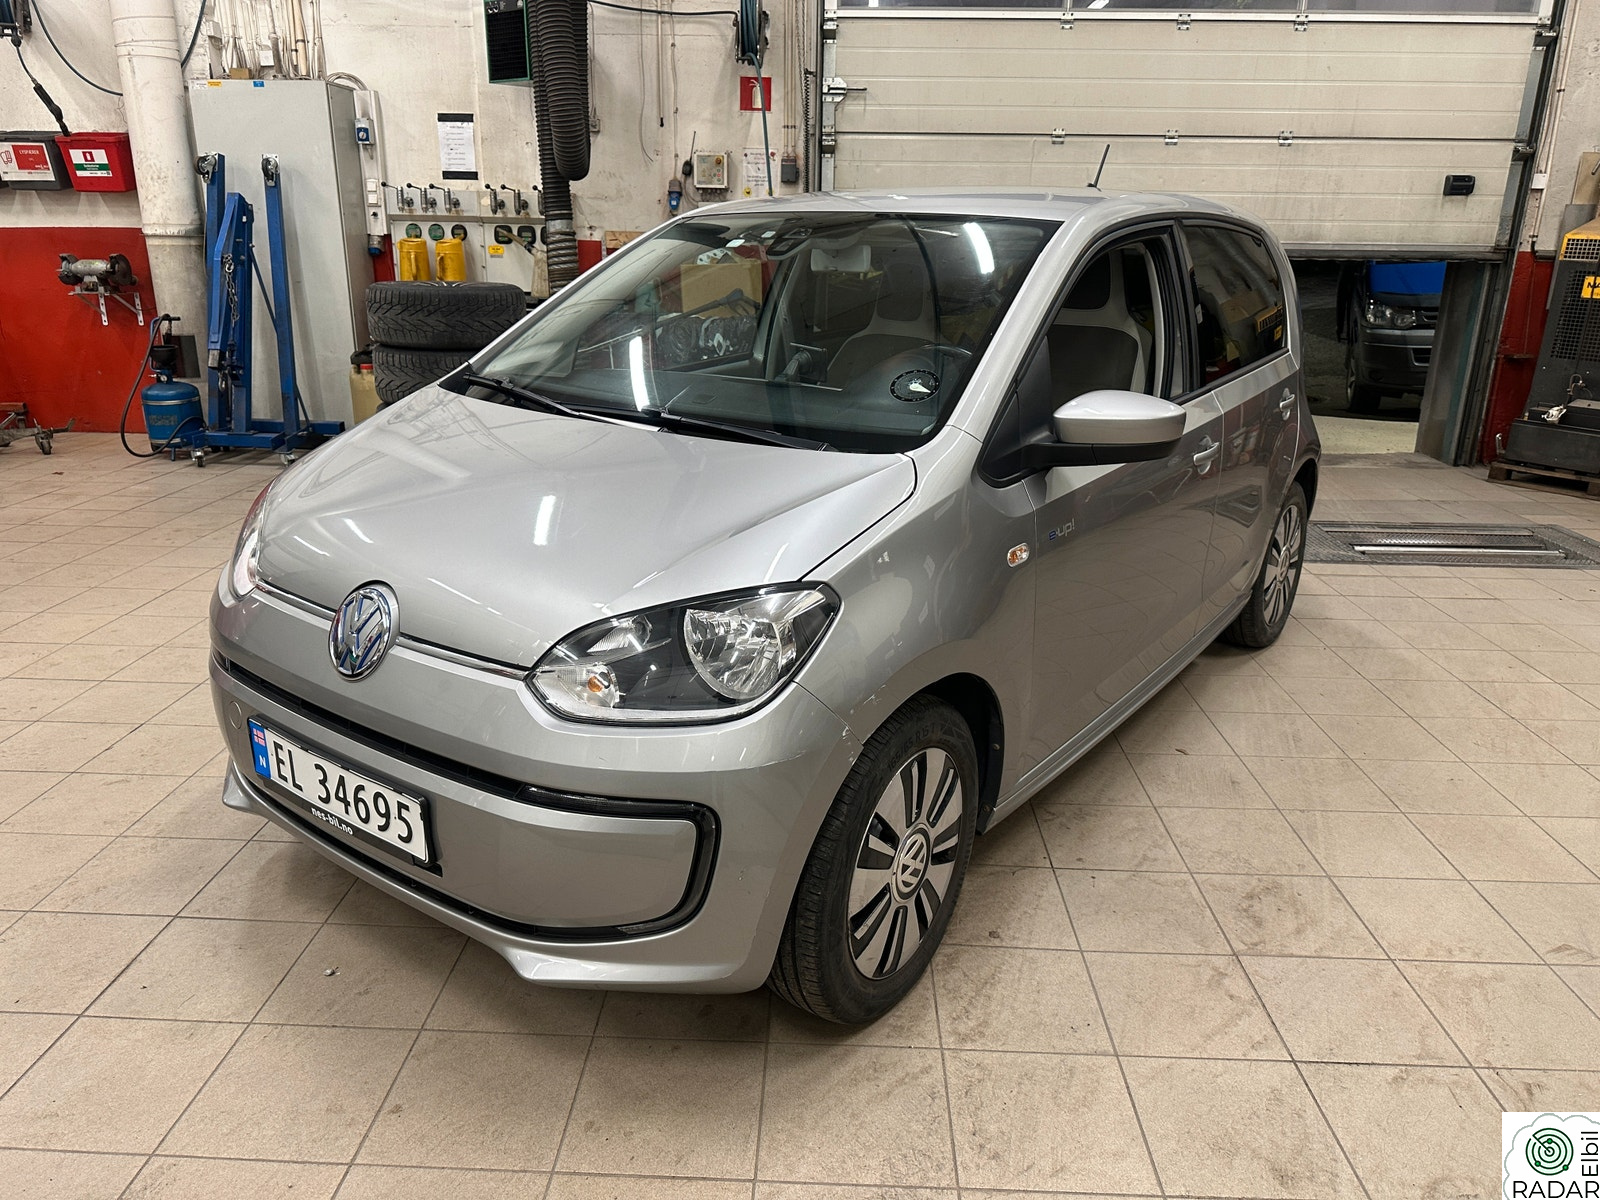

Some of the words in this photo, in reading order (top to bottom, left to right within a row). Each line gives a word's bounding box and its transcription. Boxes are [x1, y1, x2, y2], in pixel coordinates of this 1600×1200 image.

[258, 755, 266, 768] N
[272, 740, 304, 792] EL
[314, 763, 413, 844] 34695
[311, 807, 354, 836] nes-bil.no
